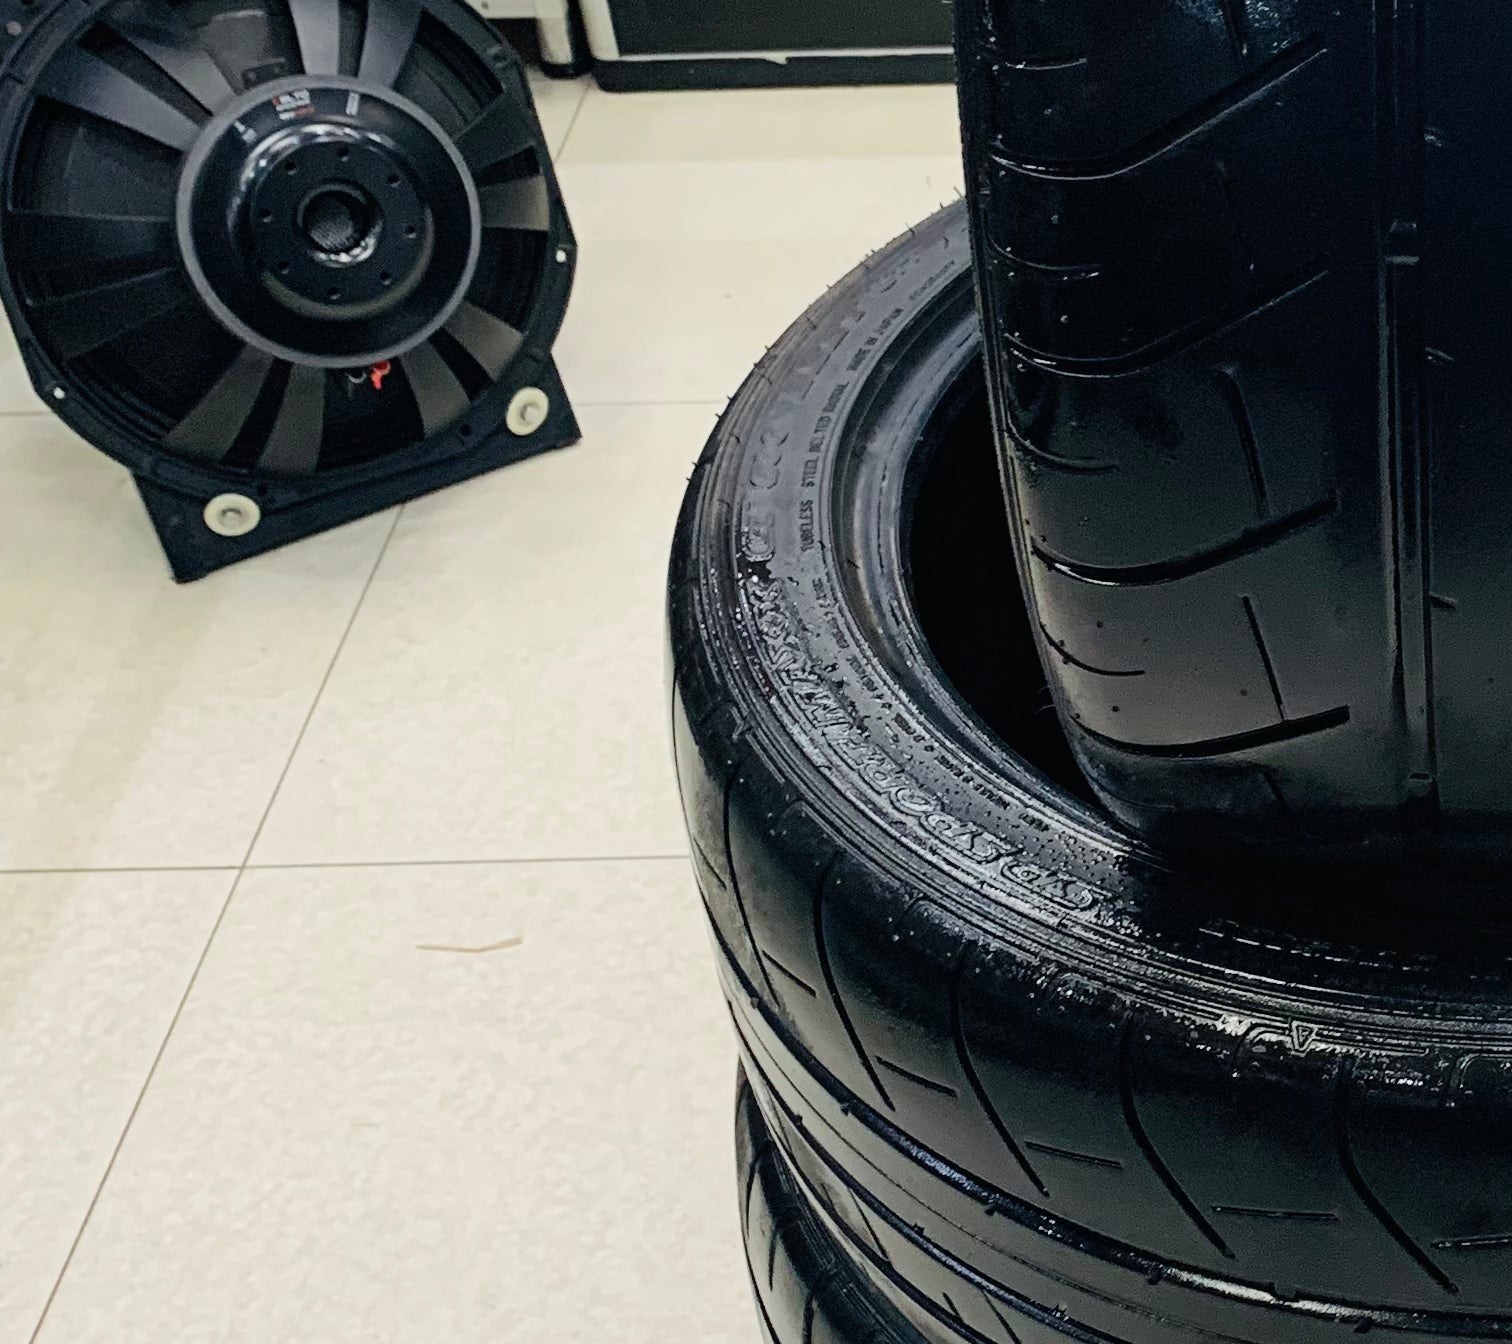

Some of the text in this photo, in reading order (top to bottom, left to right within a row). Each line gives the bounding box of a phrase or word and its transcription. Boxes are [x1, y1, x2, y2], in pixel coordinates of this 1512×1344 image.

[809, 415, 831, 451] BELTED
[802, 456, 818, 487] STEEL
[802, 499, 816, 552] TUBELESS
[834, 733, 1001, 853] SPORT
[1001, 856, 1097, 910] SP
